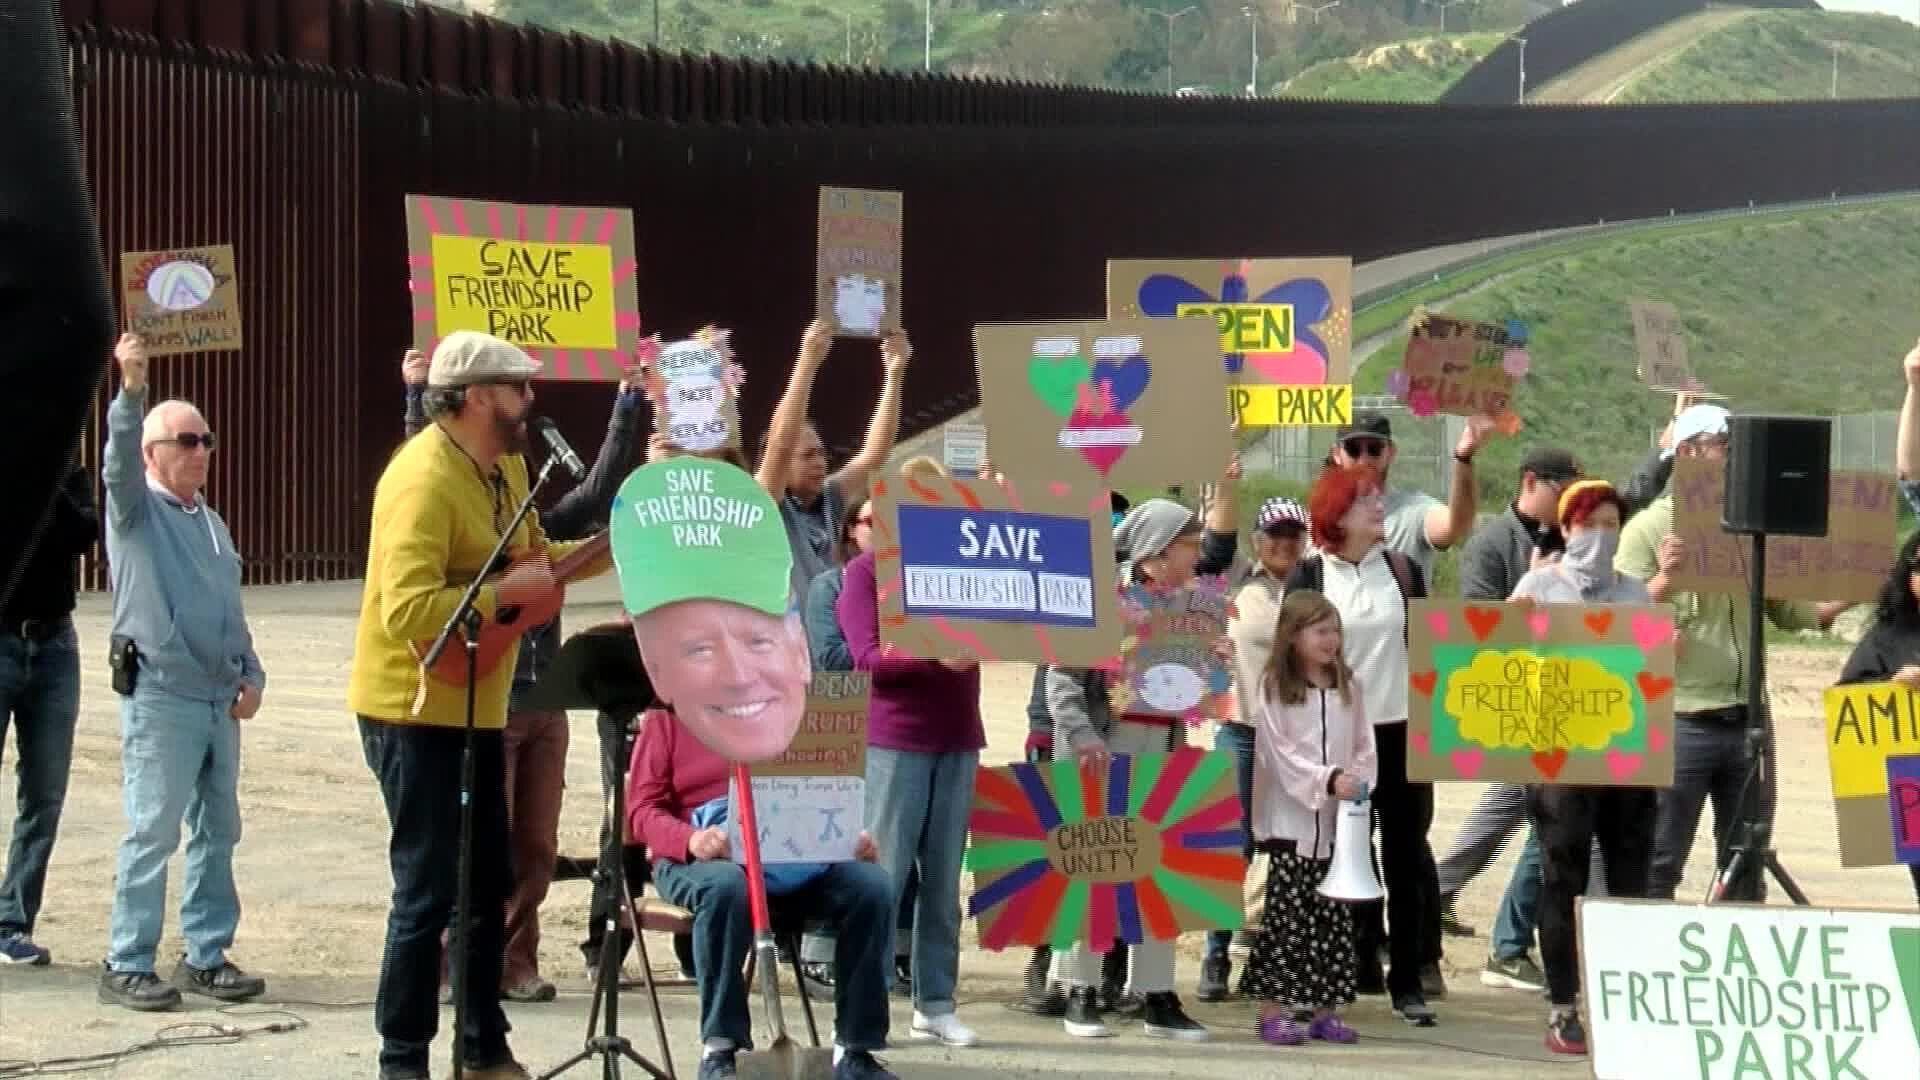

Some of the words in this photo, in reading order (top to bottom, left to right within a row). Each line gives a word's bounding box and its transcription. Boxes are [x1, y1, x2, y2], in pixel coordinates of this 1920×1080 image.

[480, 239, 573, 279] SAVE
[447, 275, 594, 313] FRIENDSHIP
[488, 308, 557, 345] PARK
[1183, 308, 1292, 350] PEN
[658, 349, 717, 369] REPAIR
[679, 387, 713, 402] NOT
[1278, 388, 1347, 423] PARK
[665, 468, 715, 493] SAVE
[634, 495, 764, 528] FRIENDSHIP
[671, 525, 723, 547] PARK
[958, 517, 1044, 564] SAVE
[911, 570, 1035, 605] FRIENDSHIP
[1043, 577, 1089, 609] PARK
[806, 674, 867, 699] IDEN!
[1504, 657, 1571, 688] OPEN
[1460, 682, 1623, 718] FRIENDSHIP
[804, 710, 864, 735] RUMP
[1500, 713, 1571, 745] PARK
[1057, 818, 1138, 850] CHOOSE
[1061, 847, 1138, 875] UNITY
[1678, 921, 1851, 980] SAVE
[1599, 970, 1890, 1033] FRIENDSHIP
[1695, 1028, 1870, 1080] PARK
